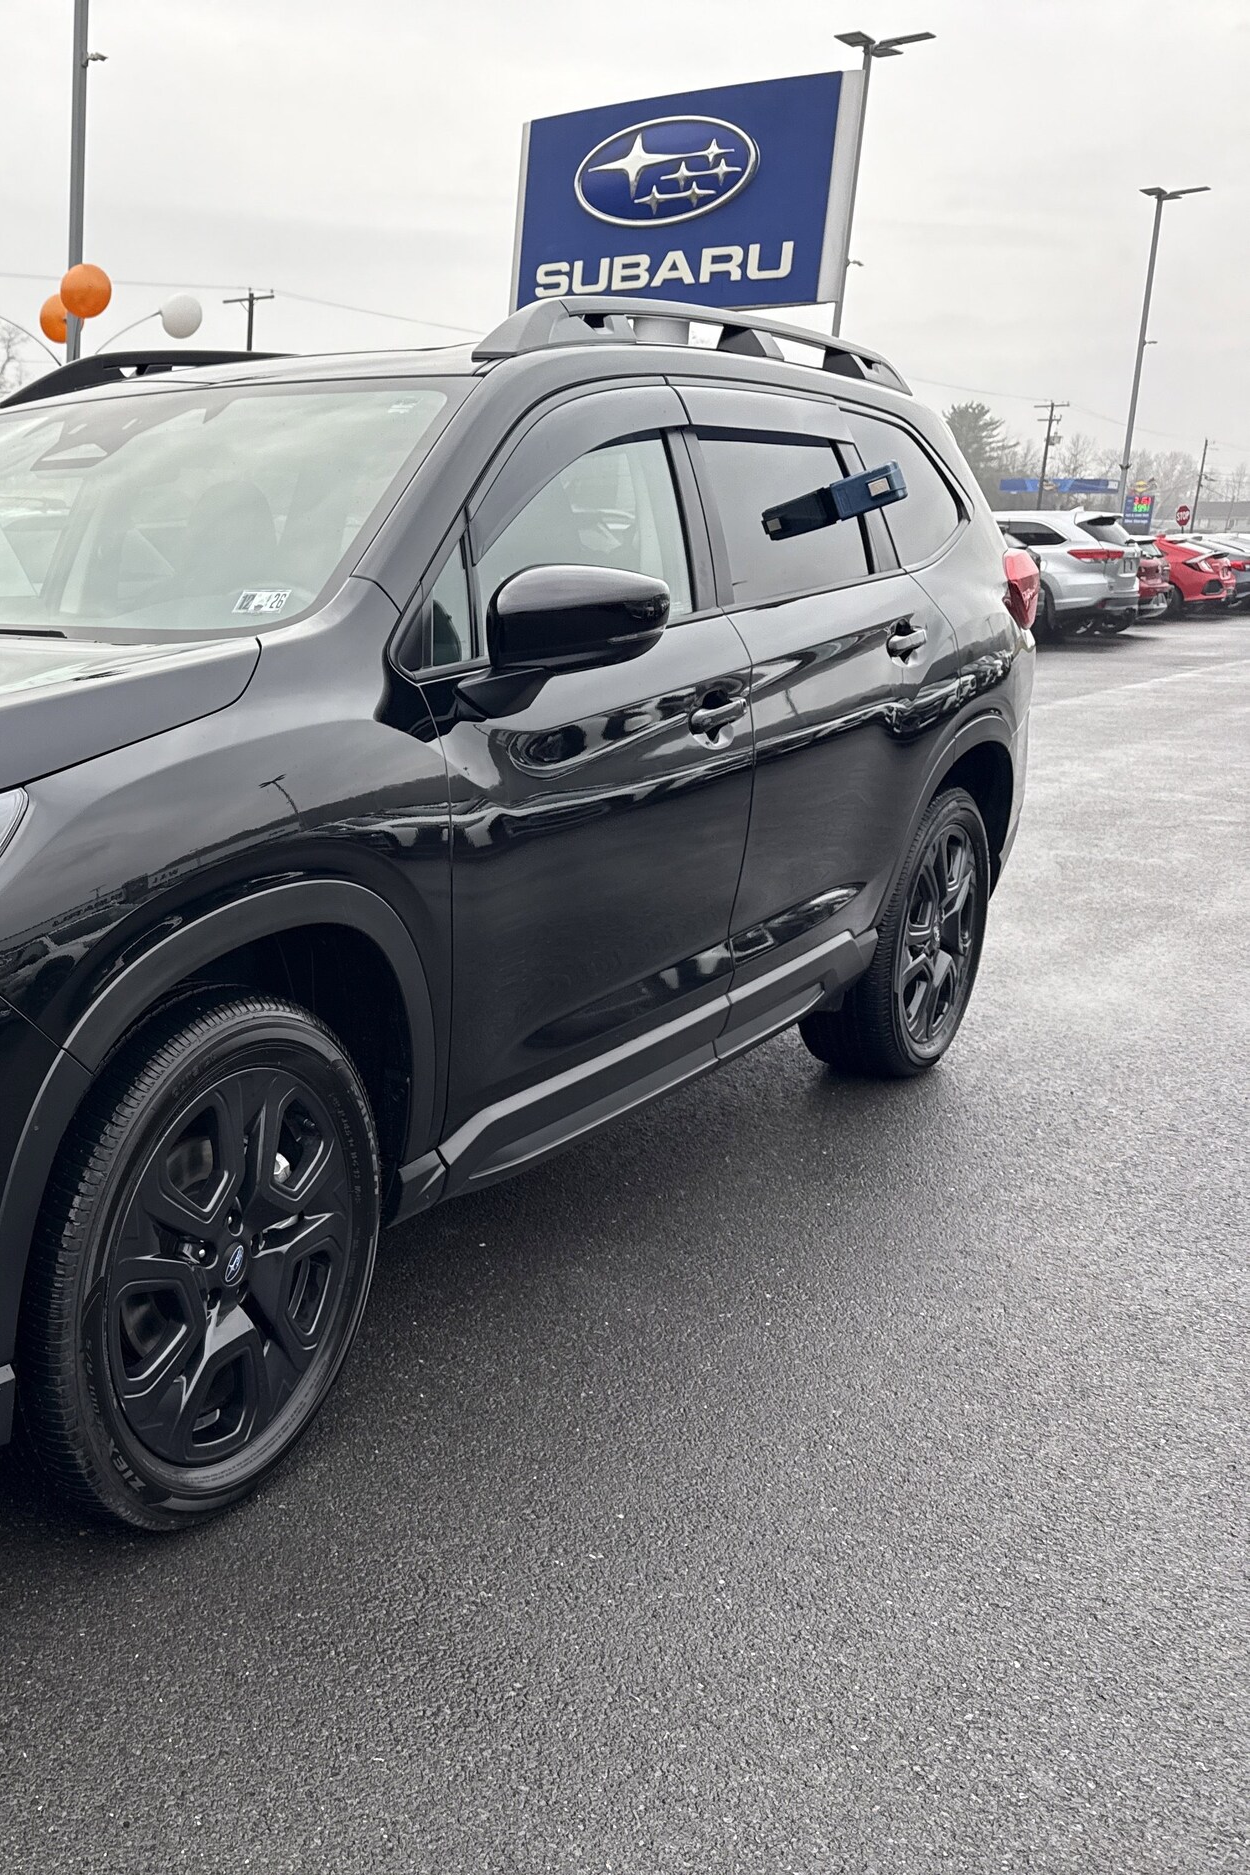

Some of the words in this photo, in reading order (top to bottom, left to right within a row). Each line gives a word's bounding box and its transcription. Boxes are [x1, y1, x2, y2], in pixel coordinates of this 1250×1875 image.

[535, 240, 794, 298] SUBARU
[1176, 511, 1190, 522] STOP
[238, 593, 257, 610] 12
[269, 593, 287, 609] 26
[108, 1437, 147, 1492] ZIEX
